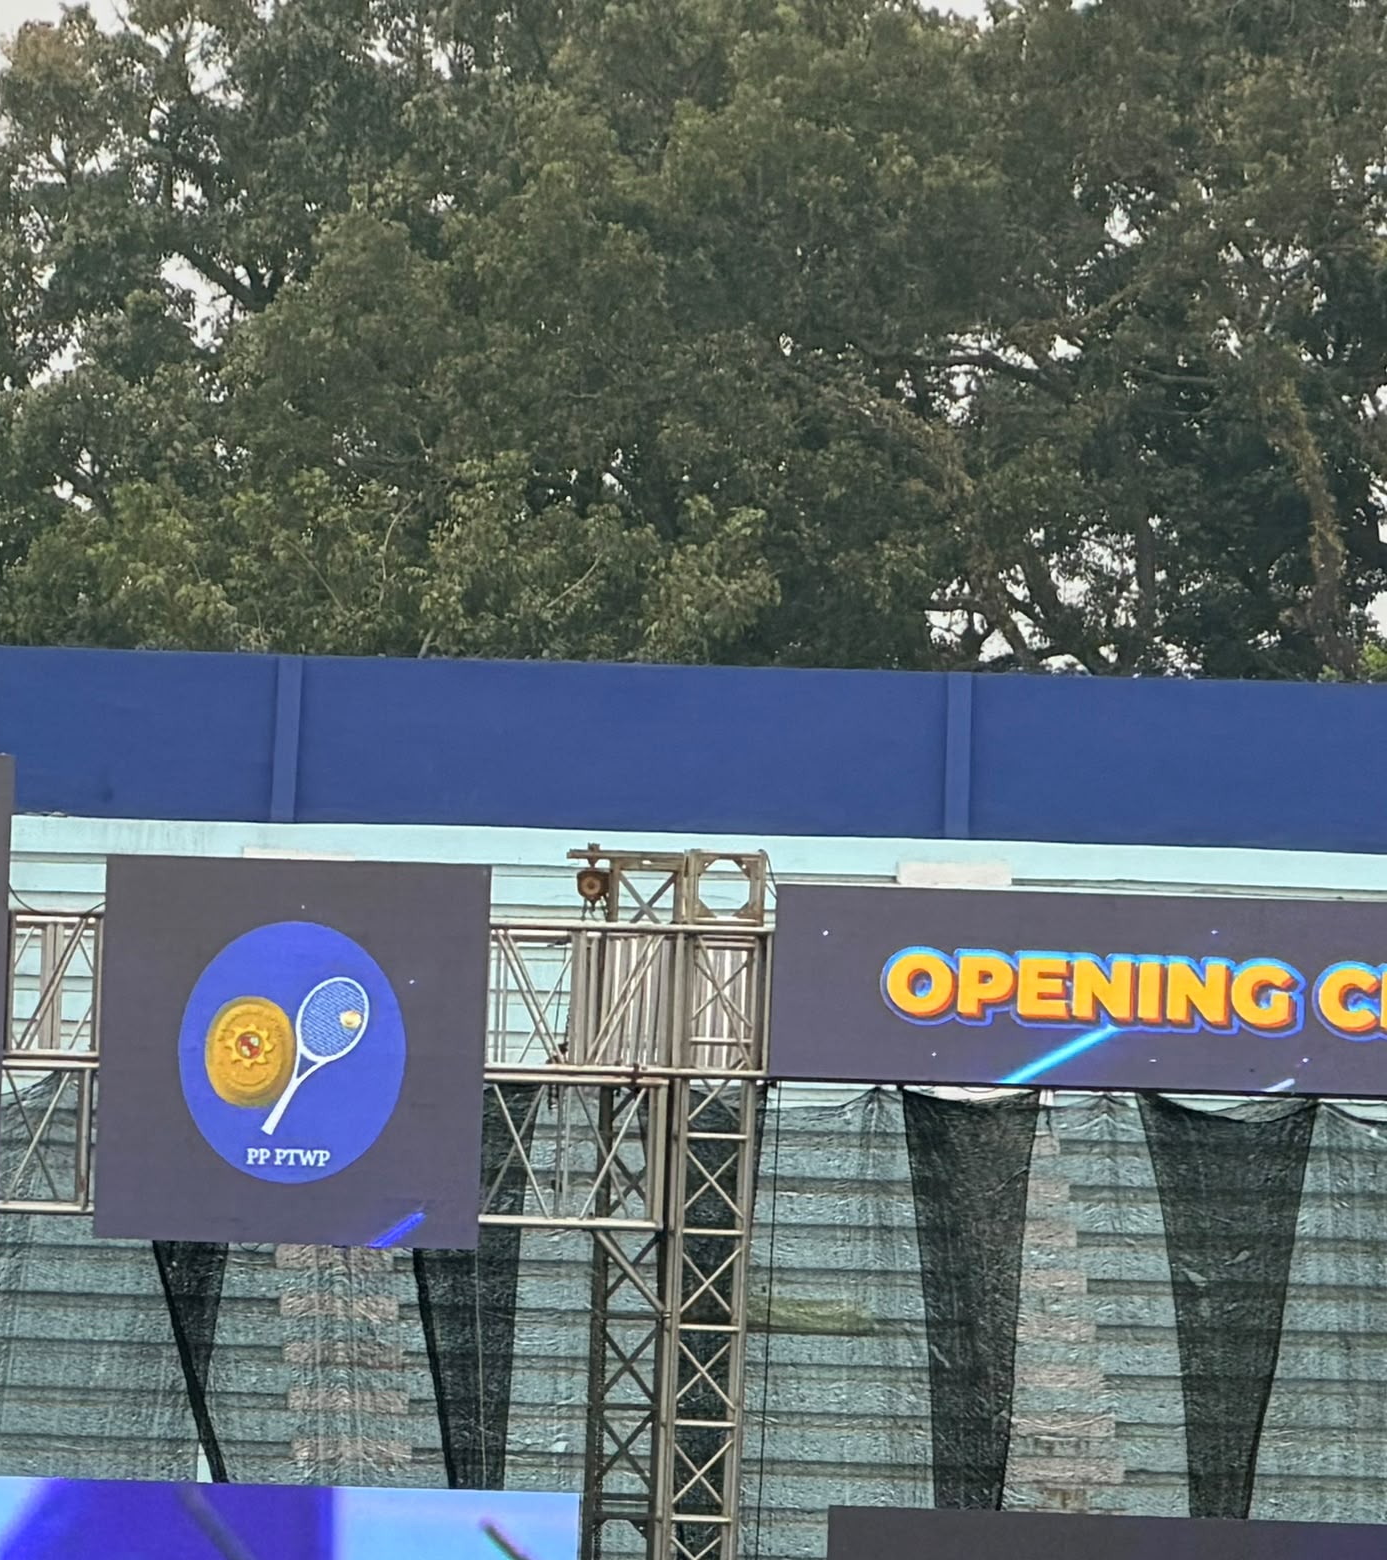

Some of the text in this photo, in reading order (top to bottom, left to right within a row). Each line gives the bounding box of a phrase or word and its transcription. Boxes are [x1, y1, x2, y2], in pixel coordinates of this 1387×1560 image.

[883, 947, 1387, 1041] OPENING C
[246, 1147, 331, 1167] PP PTWP
